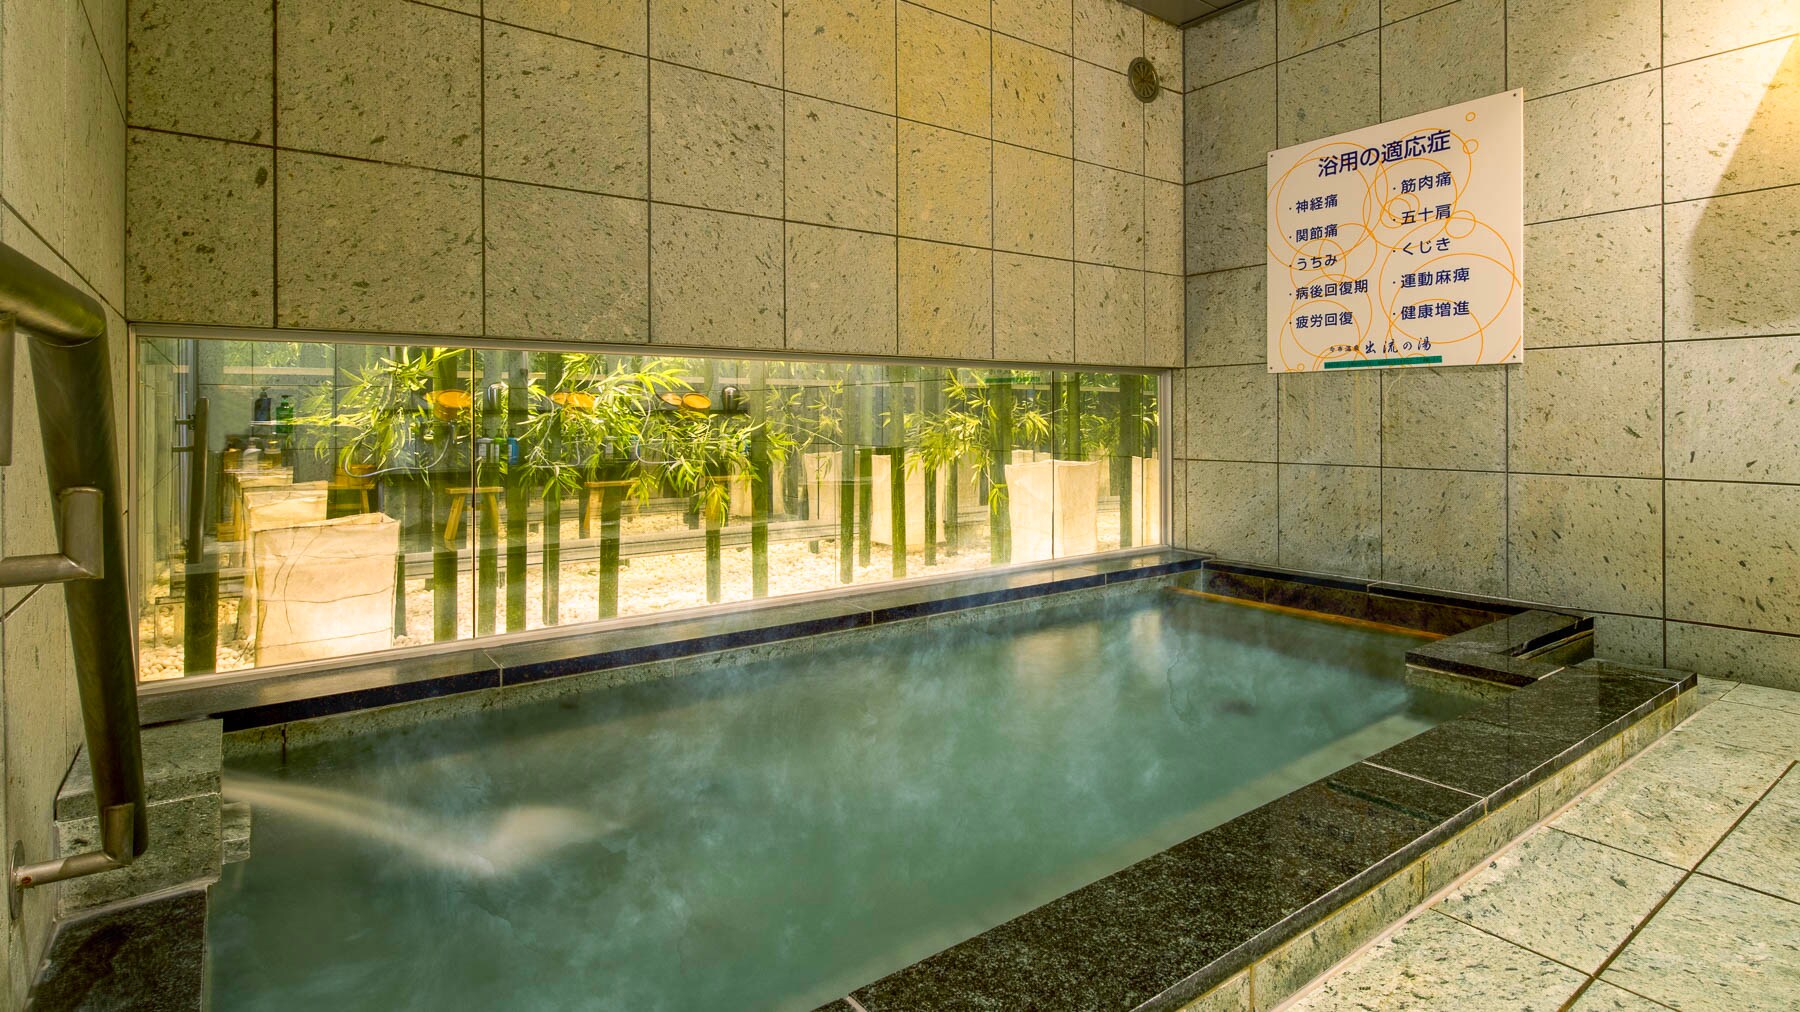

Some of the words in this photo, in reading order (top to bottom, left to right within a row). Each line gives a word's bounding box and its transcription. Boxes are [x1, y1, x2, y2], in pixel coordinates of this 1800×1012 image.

[1317, 129, 1451, 178] 浴用の適応症
[1366, 337, 1432, 354] 出流の湯
